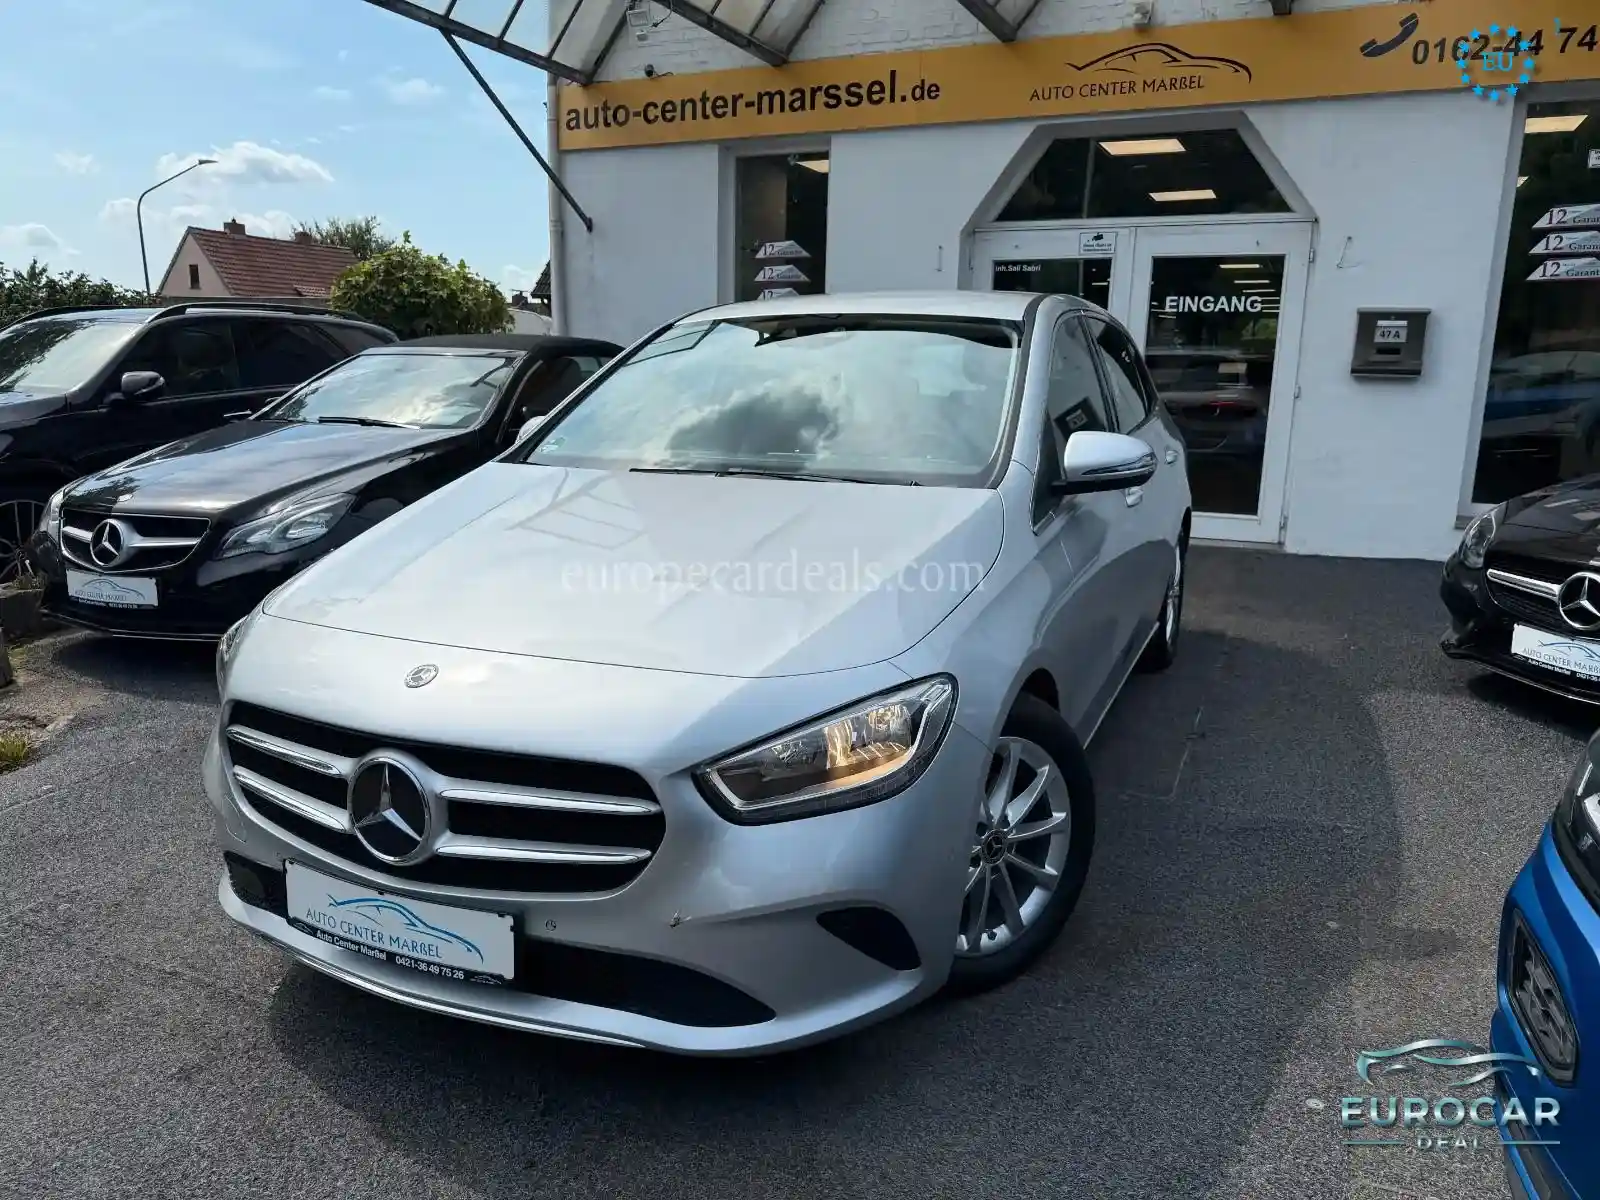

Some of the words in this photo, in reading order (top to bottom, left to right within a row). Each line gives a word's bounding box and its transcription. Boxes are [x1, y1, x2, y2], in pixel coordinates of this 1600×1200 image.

[1559, 25, 1599, 53] 74
[1029, 85, 1074, 101] AUTO
[1079, 80, 1138, 98] CENTER
[565, 70, 941, 131] auto-center-marssel.de
[1546, 208, 1567, 225] 12
[1543, 235, 1564, 251] 12
[1539, 262, 1561, 278] 12
[1165, 296, 1262, 313] EINGANG
[1379, 330, 1391, 339] 47
[1392, 330, 1401, 339] A
[1522, 648, 1542, 659] AUTO
[1544, 653, 1570, 666] CENTER
[306, 908, 337, 928] AUTO
[340, 920, 384, 945] CENTER
[316, 930, 333, 944] Auto
[333, 936, 360, 953] Center
[395, 956, 428, 973] 0421-36
[429, 964, 440, 975] 49
[440, 967, 452, 977] 75
[452, 970, 465, 980] 26
